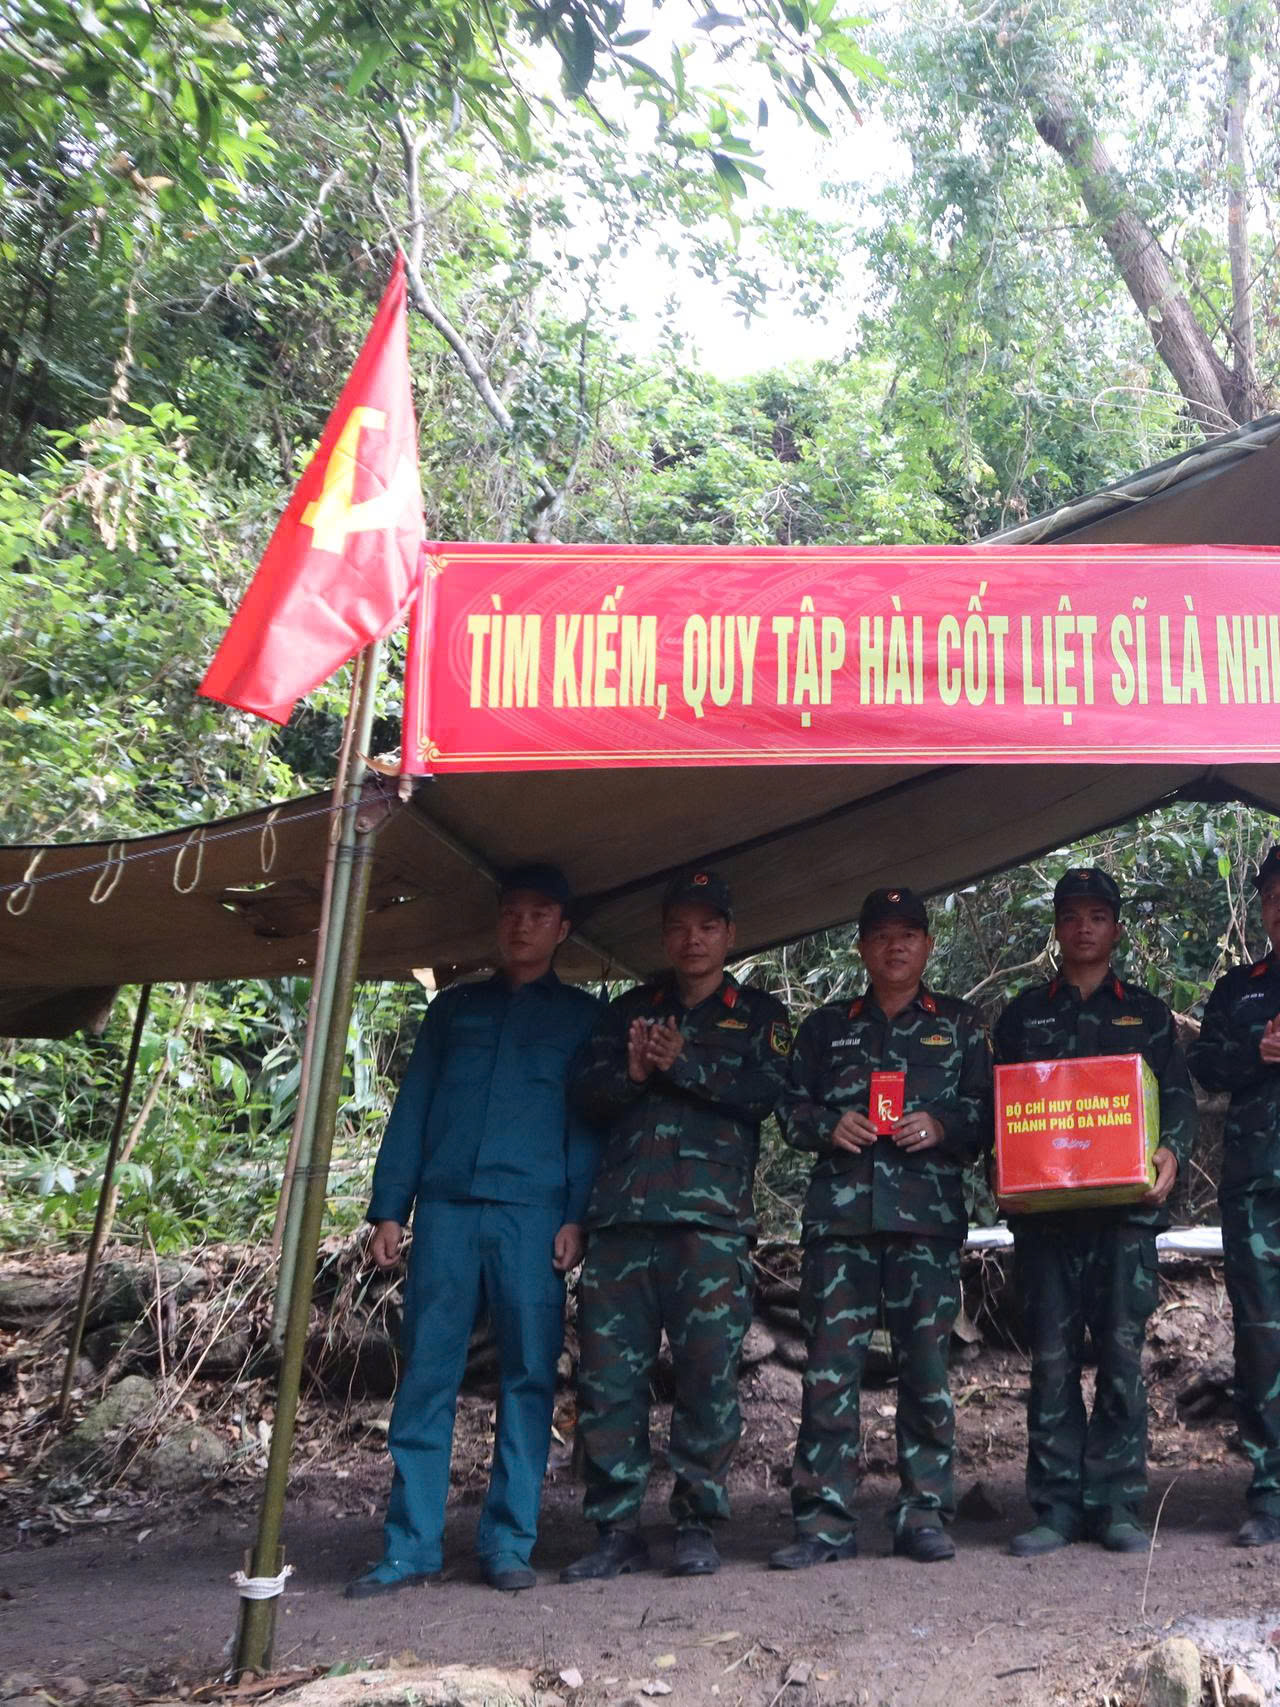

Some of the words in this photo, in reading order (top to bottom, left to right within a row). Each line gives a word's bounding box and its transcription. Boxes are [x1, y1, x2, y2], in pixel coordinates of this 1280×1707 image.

[467, 594, 541, 708] TÌM
[552, 585, 668, 720] KIẾM,
[682, 614, 761, 718] QUY
[772, 595, 846, 727] TẬP
[859, 595, 924, 705] HÀI
[937, 580, 1009, 706] CỐT
[1021, 595, 1098, 726] LIỆT
[1110, 596, 1149, 706] SĨ
[1159, 594, 1208, 705] LÀ
[1006, 1102, 1022, 1119] BỘ
[1048, 1099, 1073, 1113] HUY
[1075, 1095, 1109, 1112] QUÂN
[1112, 1094, 1130, 1110] SỰ
[1007, 1118, 1047, 1134] THÀNH
[1050, 1113, 1075, 1130] PHỐ
[1077, 1113, 1095, 1128] ĐÀ
